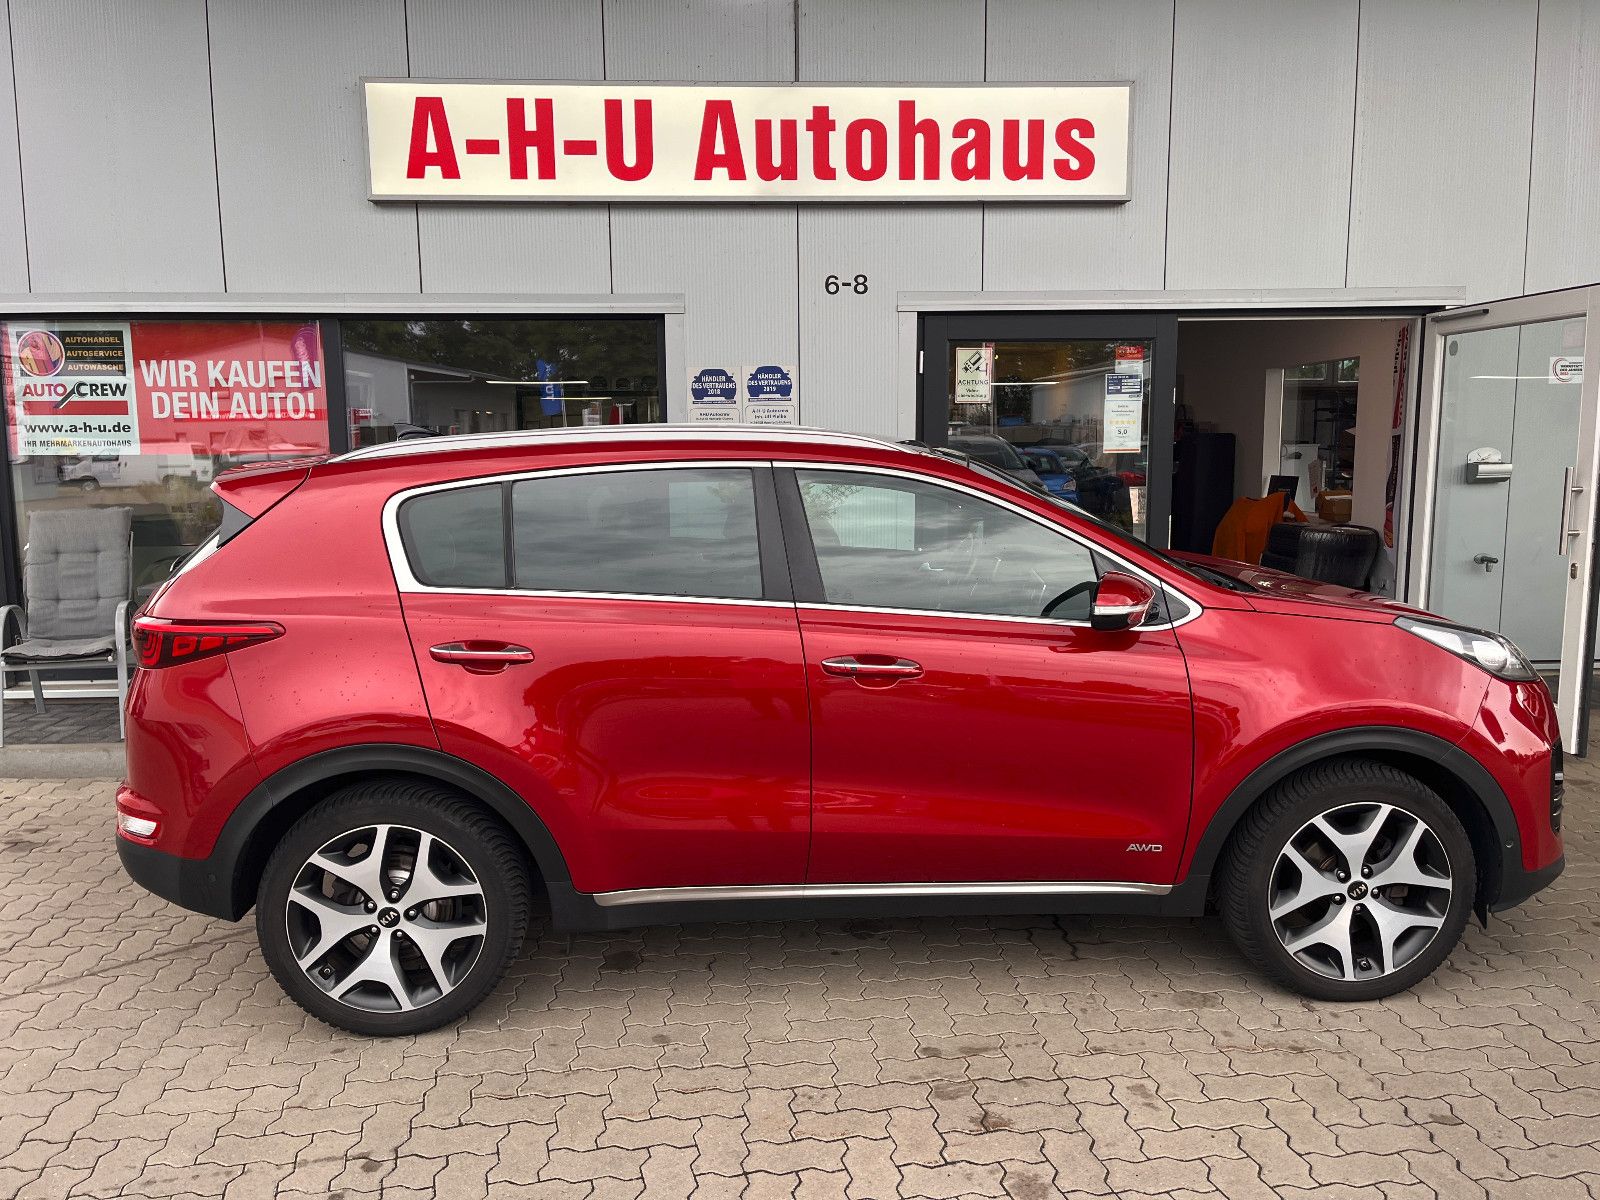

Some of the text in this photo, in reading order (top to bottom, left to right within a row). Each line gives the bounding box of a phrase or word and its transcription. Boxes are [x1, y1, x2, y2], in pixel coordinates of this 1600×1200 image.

[406, 95, 1096, 182] A-H-U Autohaus
[824, 273, 869, 295] 6-8
[139, 359, 322, 389] WIR KAUFEN
[151, 391, 317, 420] DEIN AUTO!
[24, 421, 131, 433] www.a-h-u.de
[24, 439, 132, 448] IHR MEHRMARKENAUTOHAUS
[1125, 843, 1163, 852] AWD
[380, 911, 397, 925] KIA
